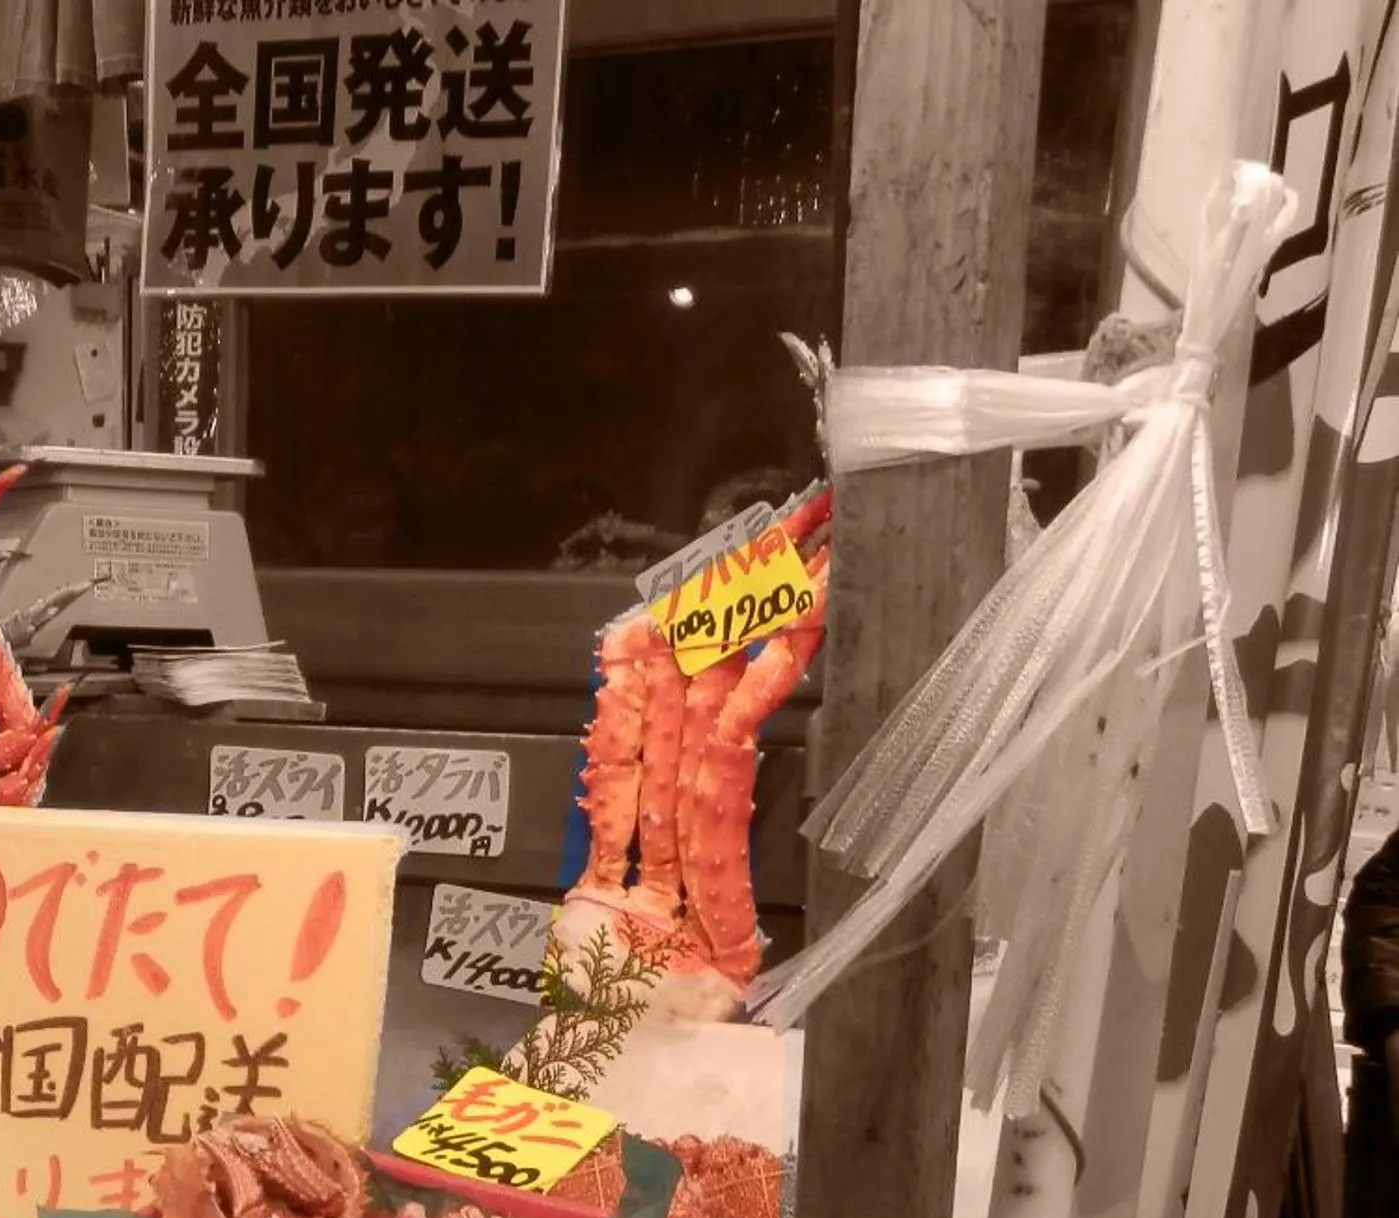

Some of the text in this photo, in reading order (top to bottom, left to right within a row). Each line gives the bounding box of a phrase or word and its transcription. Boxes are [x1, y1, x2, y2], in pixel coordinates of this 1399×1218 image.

[166, 19, 534, 150] 全国発送
[160, 156, 522, 271] 承ります!
